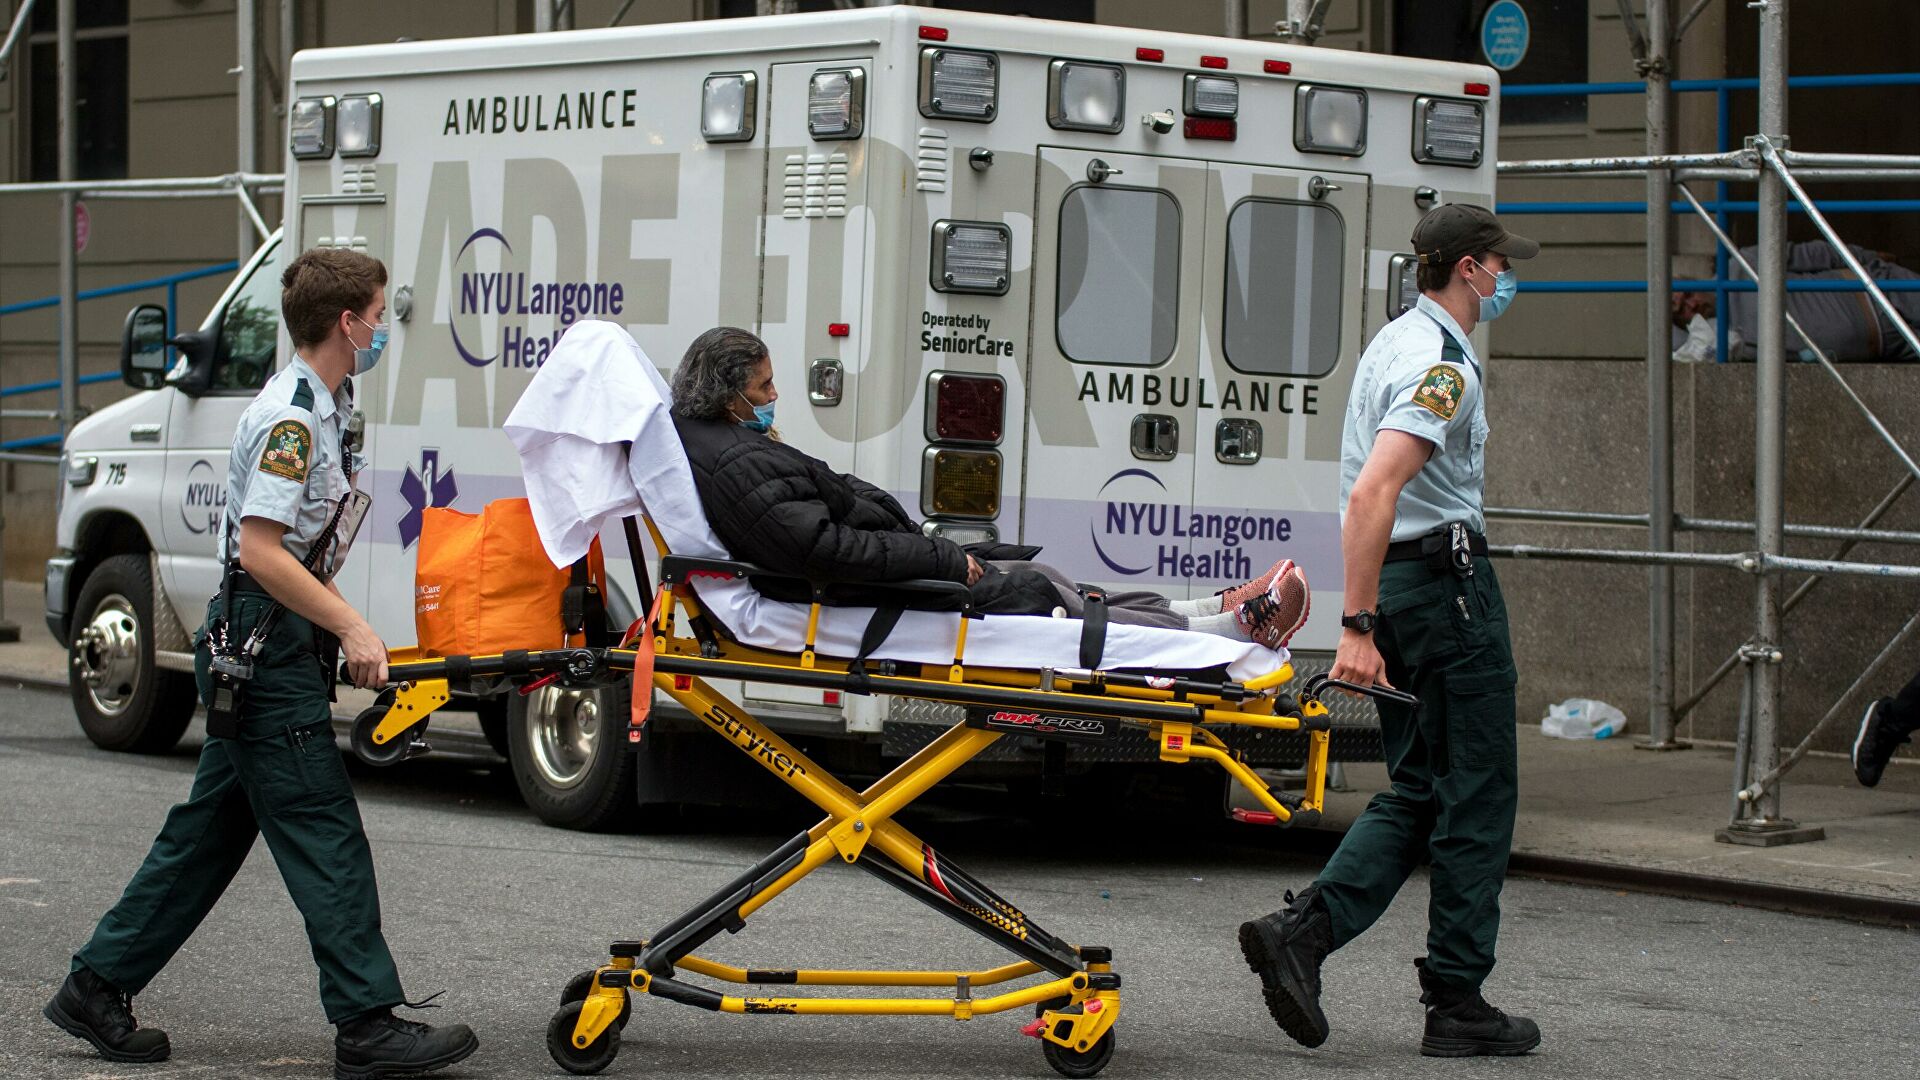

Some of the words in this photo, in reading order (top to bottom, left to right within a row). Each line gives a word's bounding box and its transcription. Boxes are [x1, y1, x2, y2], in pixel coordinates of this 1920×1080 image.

[443, 89, 637, 136] AMBULANCE
[922, 311, 974, 329] Operated
[976, 314, 991, 333] by
[921, 330, 1014, 357] SeniorCare
[1078, 371, 1319, 415] AMBULANCE
[105, 462, 128, 486] 715
[1157, 545, 1251, 579] Health
[992, 711, 1101, 730] MX-PRO
